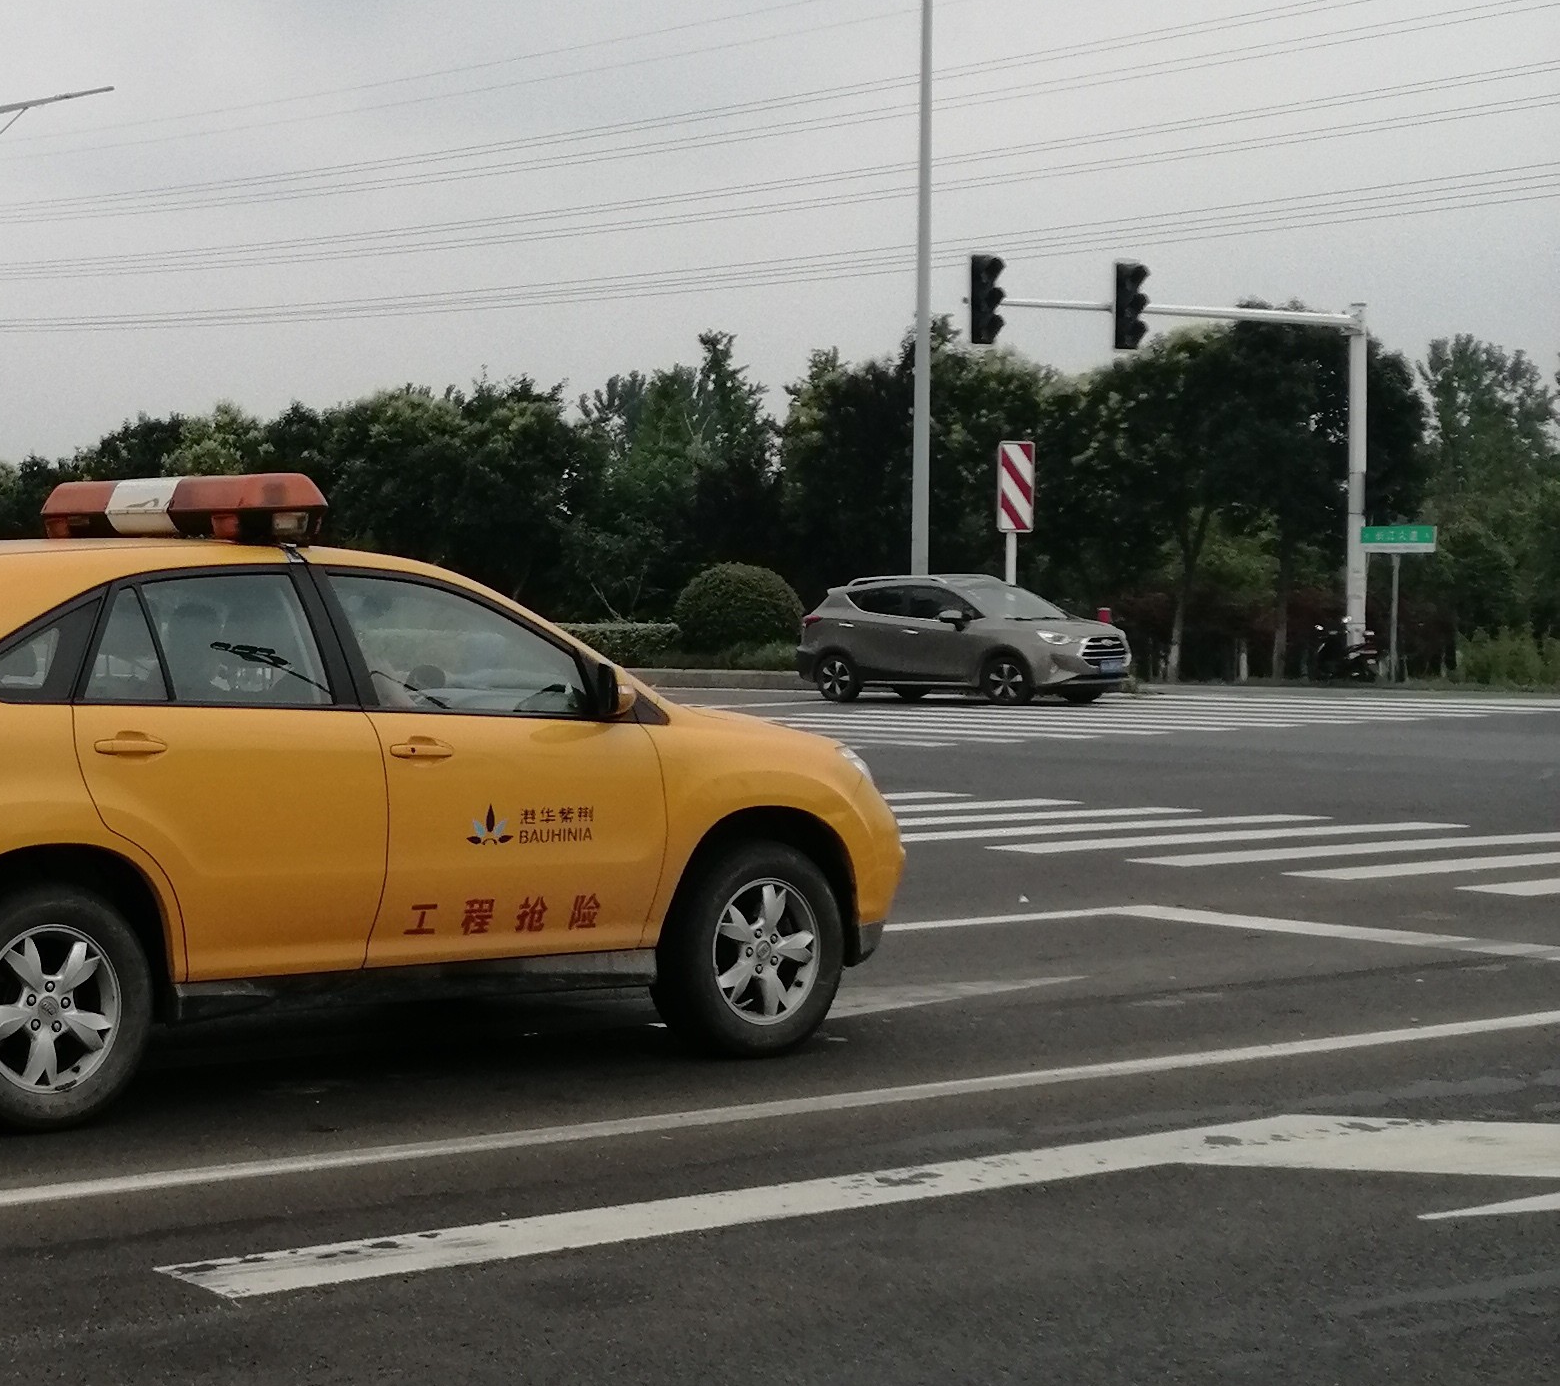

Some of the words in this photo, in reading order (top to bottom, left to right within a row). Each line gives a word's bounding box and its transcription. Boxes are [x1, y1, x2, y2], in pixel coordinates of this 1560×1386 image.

[520, 805, 594, 825] 港华紫荆
[519, 827, 593, 844] BAUHINIA
[403, 892, 601, 935] 工程抢险
